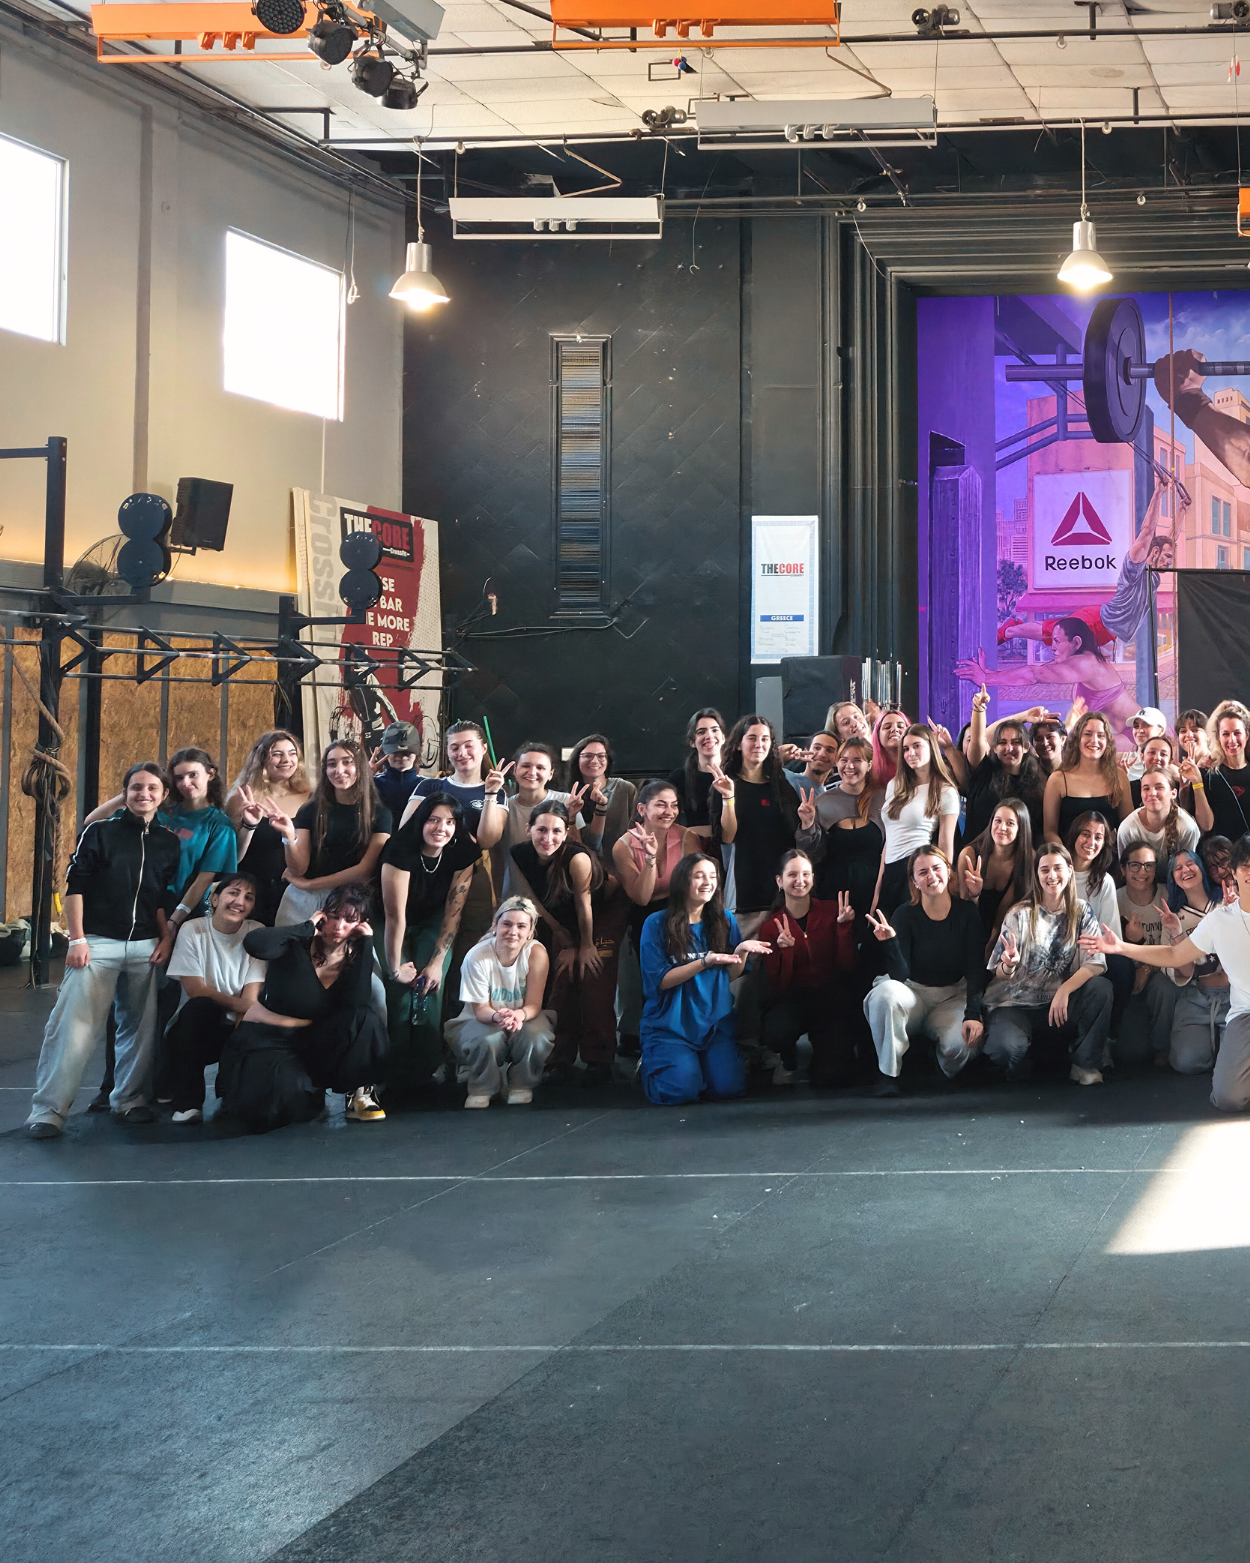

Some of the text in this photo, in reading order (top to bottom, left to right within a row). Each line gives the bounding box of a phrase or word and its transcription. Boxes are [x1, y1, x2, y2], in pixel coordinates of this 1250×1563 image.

[1045, 554, 1117, 571] Reebok
[380, 595, 403, 612] BAR
[377, 613, 410, 632] MORE
[372, 631, 394, 647] REP
